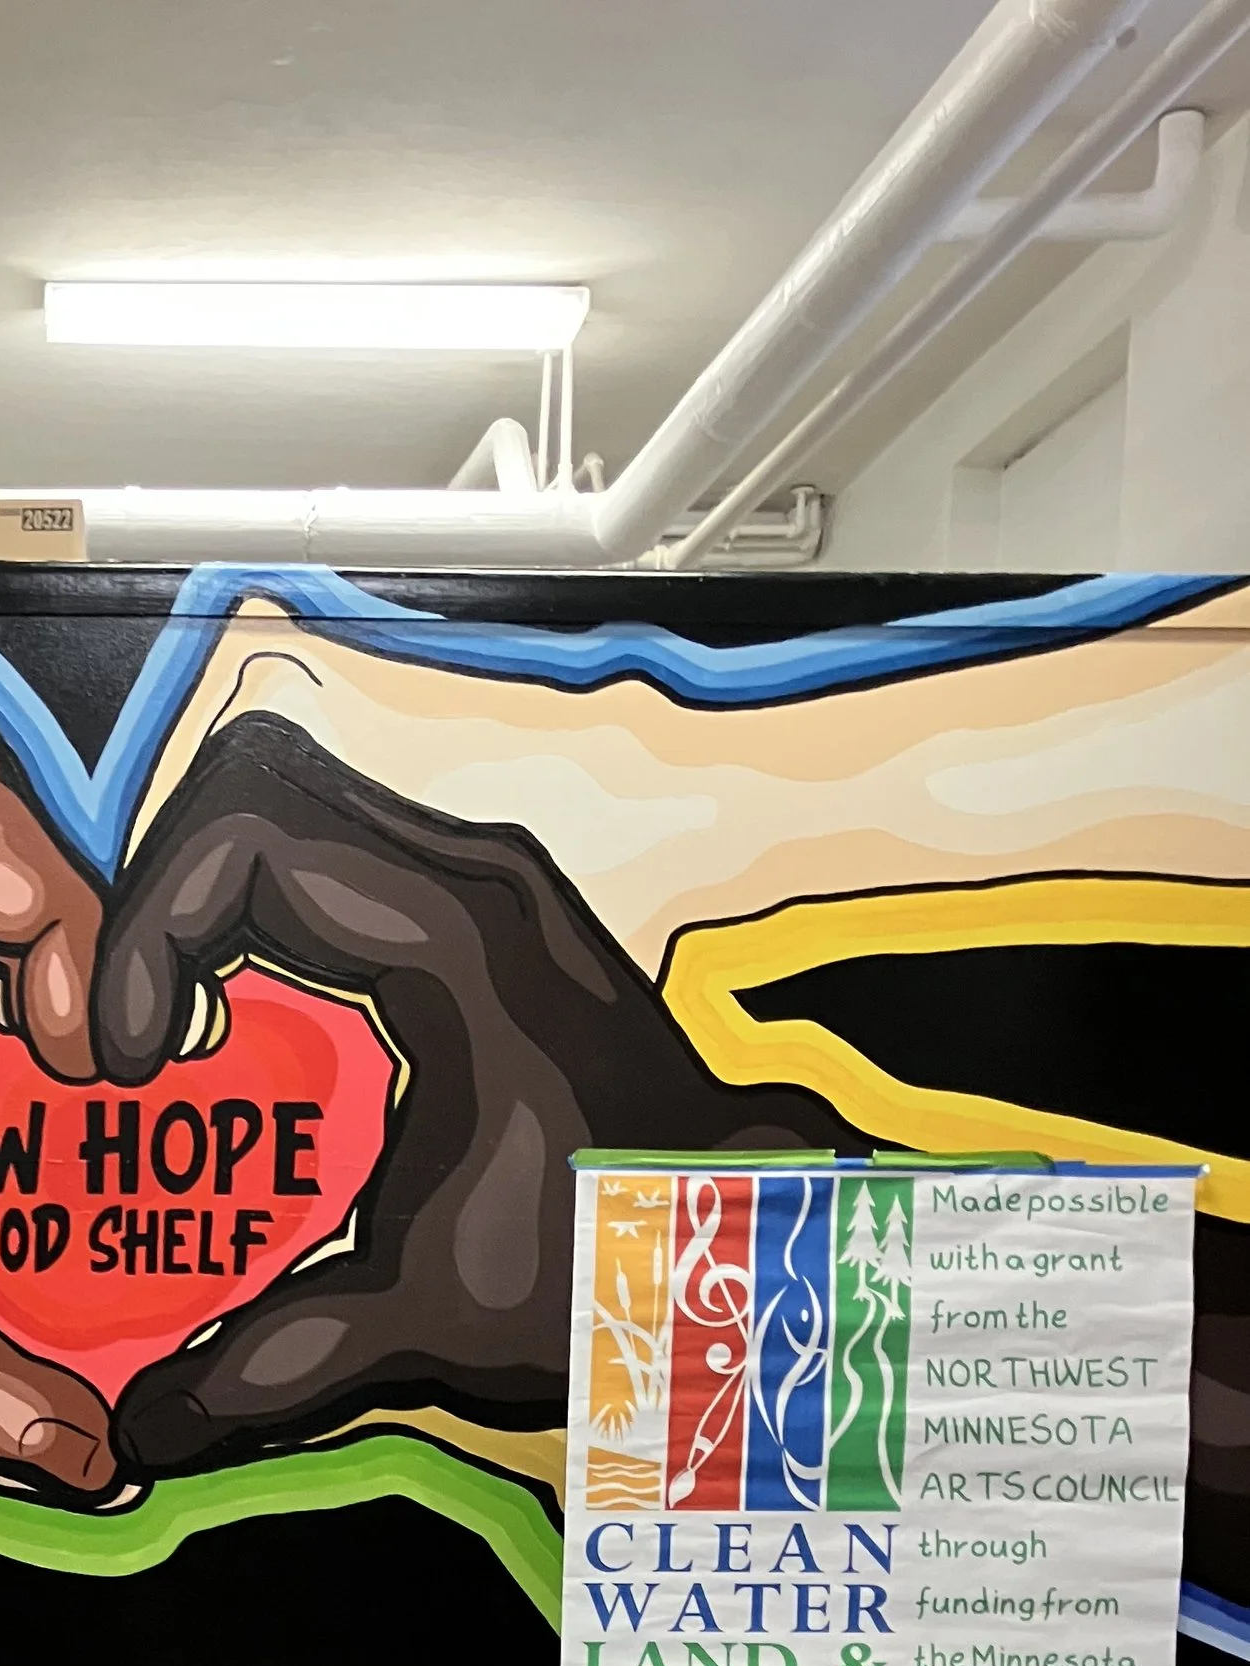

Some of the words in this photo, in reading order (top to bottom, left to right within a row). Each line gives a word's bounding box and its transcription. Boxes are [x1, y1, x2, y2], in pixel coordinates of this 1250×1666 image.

[22, 509, 72, 529] 20522
[79, 1098, 324, 1196] HOPE
[932, 1183, 1021, 1213] Made
[1027, 1184, 1169, 1221] possible
[88, 1204, 275, 1276] SHELF
[930, 1242, 999, 1271] with
[1005, 1256, 1026, 1271] a
[1033, 1245, 1123, 1278] grant
[930, 1299, 1008, 1334] from
[1015, 1301, 1067, 1329] the
[926, 1356, 1158, 1388] NORTHWEST
[924, 1413, 1133, 1445] MINNESOTA
[920, 1471, 1025, 1502] ARTS
[1032, 1473, 1180, 1503] COUNCIL
[585, 1522, 900, 1575] CLEAN
[918, 1529, 1047, 1565] through
[582, 1582, 896, 1634] WATER
[915, 1586, 1035, 1621] funding
[1041, 1587, 1120, 1621] from
